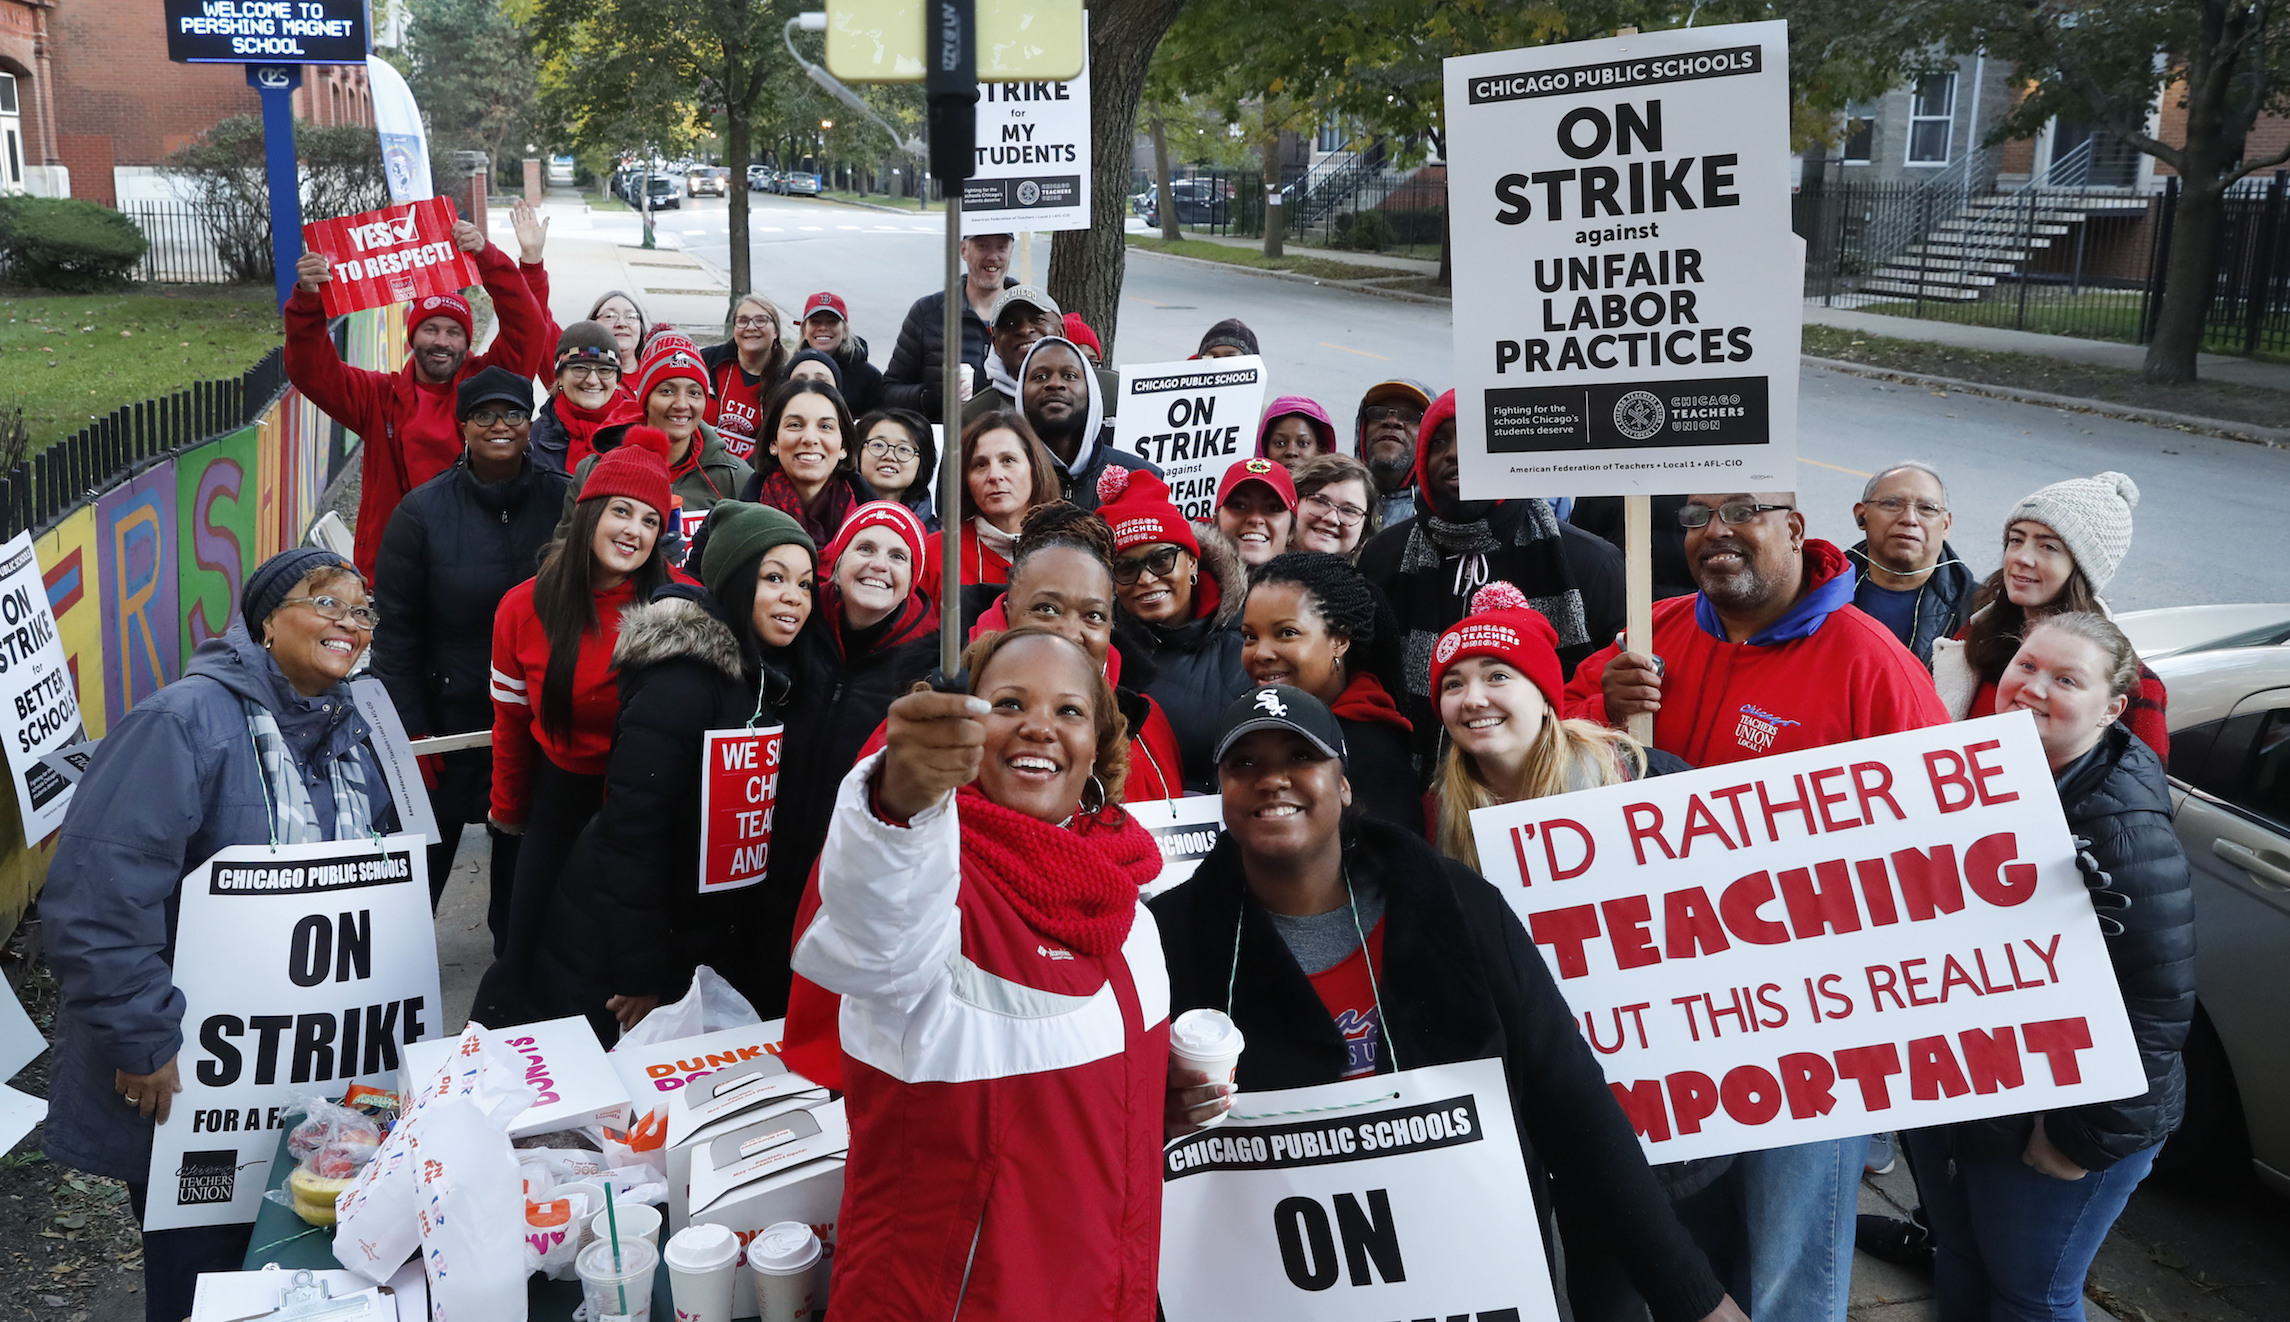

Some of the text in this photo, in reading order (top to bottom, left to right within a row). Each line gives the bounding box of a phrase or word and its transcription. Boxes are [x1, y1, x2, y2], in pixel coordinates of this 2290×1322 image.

[203, 1, 323, 19] WELCOME TO
[180, 17, 352, 37] PERSHING MAGNET
[232, 37, 305, 55] SCHOOL
[1475, 51, 1755, 99] CHICAGO PUBLIC SCHOOLS
[1011, 109, 1026, 118] for
[1002, 124, 1035, 143] MY
[1557, 99, 1663, 160] ON
[975, 144, 1076, 165] TUDENTS
[1042, 188, 1072, 196] TEACHERS
[1495, 154, 1740, 225] STRIKE
[347, 221, 393, 252] YES
[1575, 221, 1660, 247] against
[334, 260, 364, 284] TO
[364, 241, 455, 279] RESPECT!
[1534, 248, 1705, 293] UNFAIR
[1011, 288, 1037, 301] DIEGO
[1542, 290, 1699, 333] LABOR
[1495, 326, 1754, 374] PRACTICES
[1134, 371, 1256, 392] CHICAGO PUBLIC SCHOOLS
[726, 399, 756, 420] CTU
[1167, 396, 1216, 428] ON
[1493, 404, 1567, 417] Fighting for the
[1671, 394, 1741, 407] CHICAGO
[1493, 414, 1580, 426] schools Chicago's
[1672, 407, 1745, 419] TEACHERS
[1494, 425, 1574, 436] students deserve
[1672, 420, 1721, 432] UNION
[1134, 426, 1240, 464] STRIKE
[1166, 464, 1202, 478] against
[1510, 465, 1551, 474] American
[1553, 463, 1601, 472] Federation
[1603, 463, 1614, 471] of
[1615, 462, 1655, 470] Teachers
[1663, 461, 1688, 469] Local
[1704, 459, 1743, 468] AFL-CIO
[1170, 477, 1216, 501] FAIR
[1179, 500, 1212, 522] BOR
[1116, 518, 1159, 530] CHICAGO
[1116, 525, 1164, 538] TEACHERS
[1117, 532, 1148, 546] UNION
[0, 549, 31, 577] UBLIC SCHOOLS
[2, 584, 33, 626] ON
[1461, 624, 1517, 637] CHICAGO
[1461, 632, 1520, 646] TEACHERS
[1461, 640, 1500, 650] UNION
[32, 663, 44, 676] for
[14, 667, 65, 721] BETTER
[18, 692, 76, 754] SCHOOLS
[1740, 714, 1778, 736] TEACHERS
[1735, 723, 1775, 749] UNION
[1737, 738, 1758, 752] LOCAL
[722, 742, 759, 771] WE
[746, 772, 778, 804] CHI
[1510, 739, 2020, 887] I'D RATHER BE
[1155, 830, 1217, 857] SCHOOLS
[730, 842, 768, 876] AND
[218, 857, 409, 890] CHICAGO PUBLIC SCHOOLS
[1530, 831, 2037, 981] TEACHING
[289, 909, 371, 987] ON
[1575, 933, 2062, 1055] UT THIS IS REALLY
[196, 996, 425, 1087] STRIKE
[1611, 1017, 2093, 1143] MPORTANT
[193, 1109, 240, 1133] FOR
[244, 1108, 261, 1131] A
[1168, 1106, 1472, 1173] CHICAGO PUBLIC SCHOOLS
[180, 1174, 234, 1188] TEACHERS
[179, 1185, 233, 1202] UNION
[1274, 1188, 1407, 1292] ON
